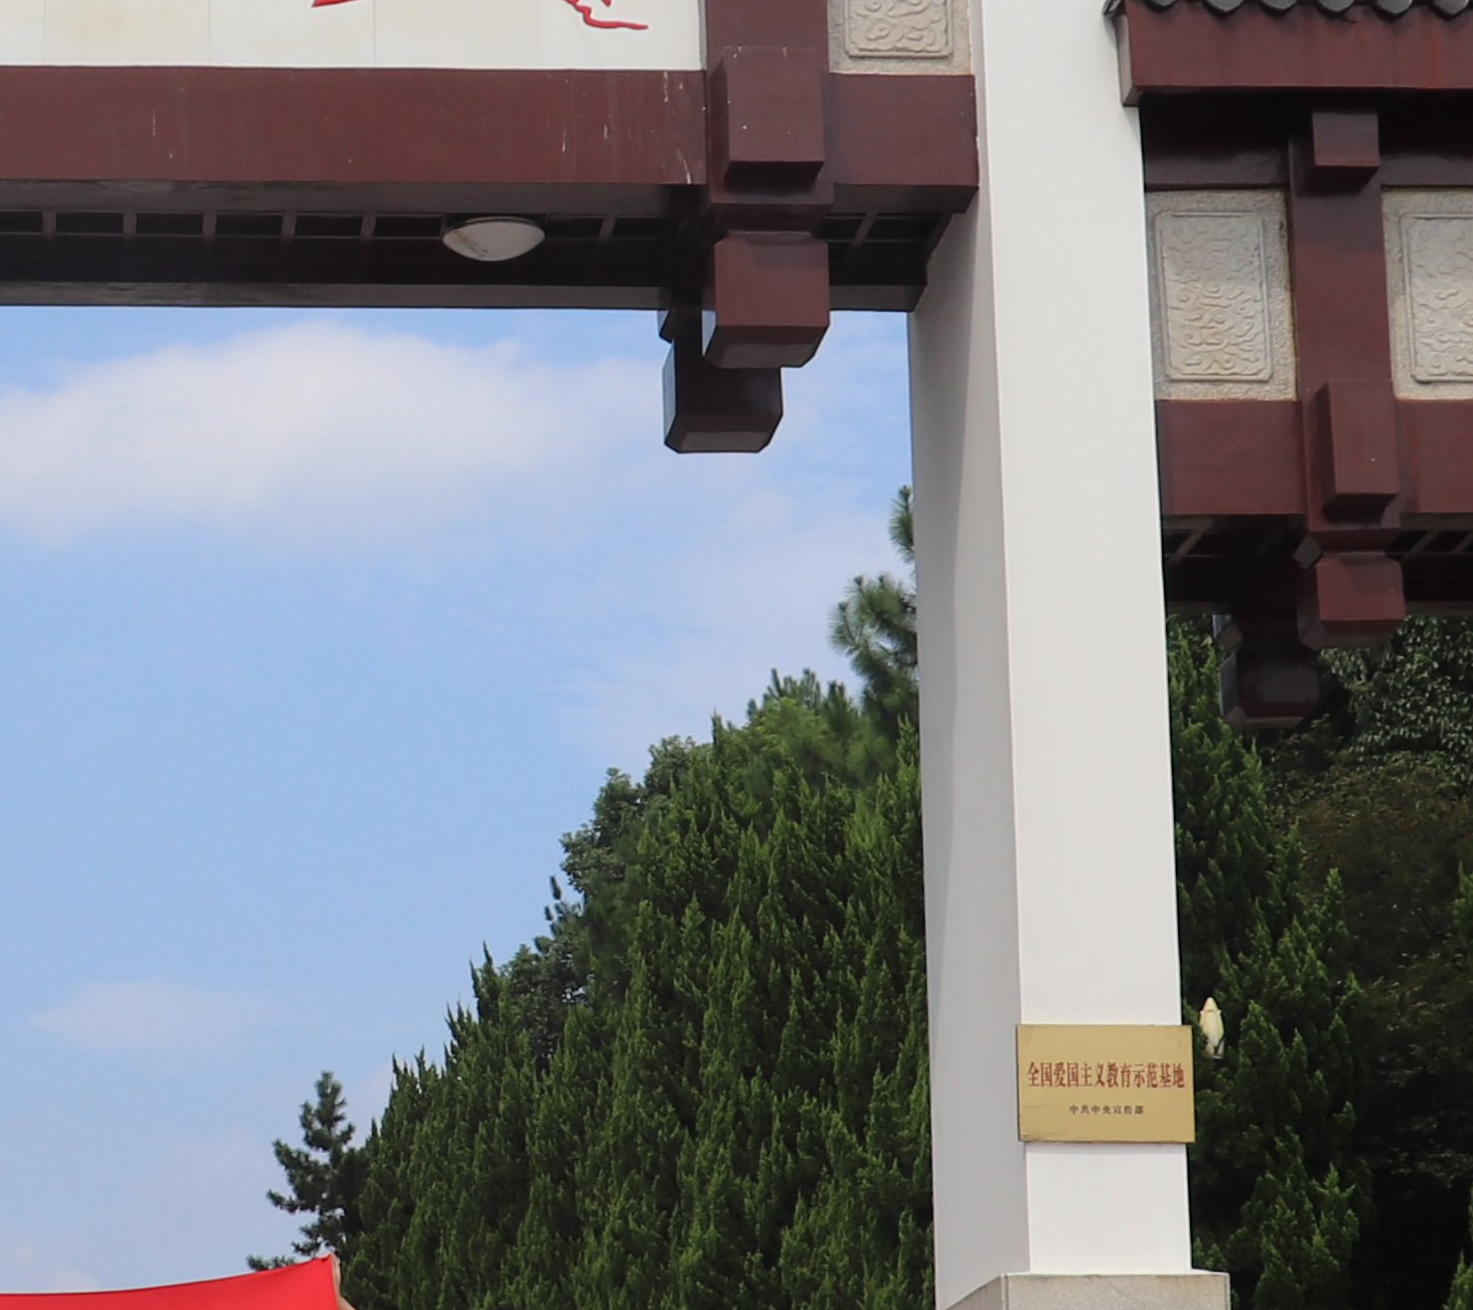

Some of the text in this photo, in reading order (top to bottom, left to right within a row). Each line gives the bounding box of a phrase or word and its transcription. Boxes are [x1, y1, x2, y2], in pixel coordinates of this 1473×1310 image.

[1027, 1061, 1186, 1089] 全国爱国主义教育示范基地
